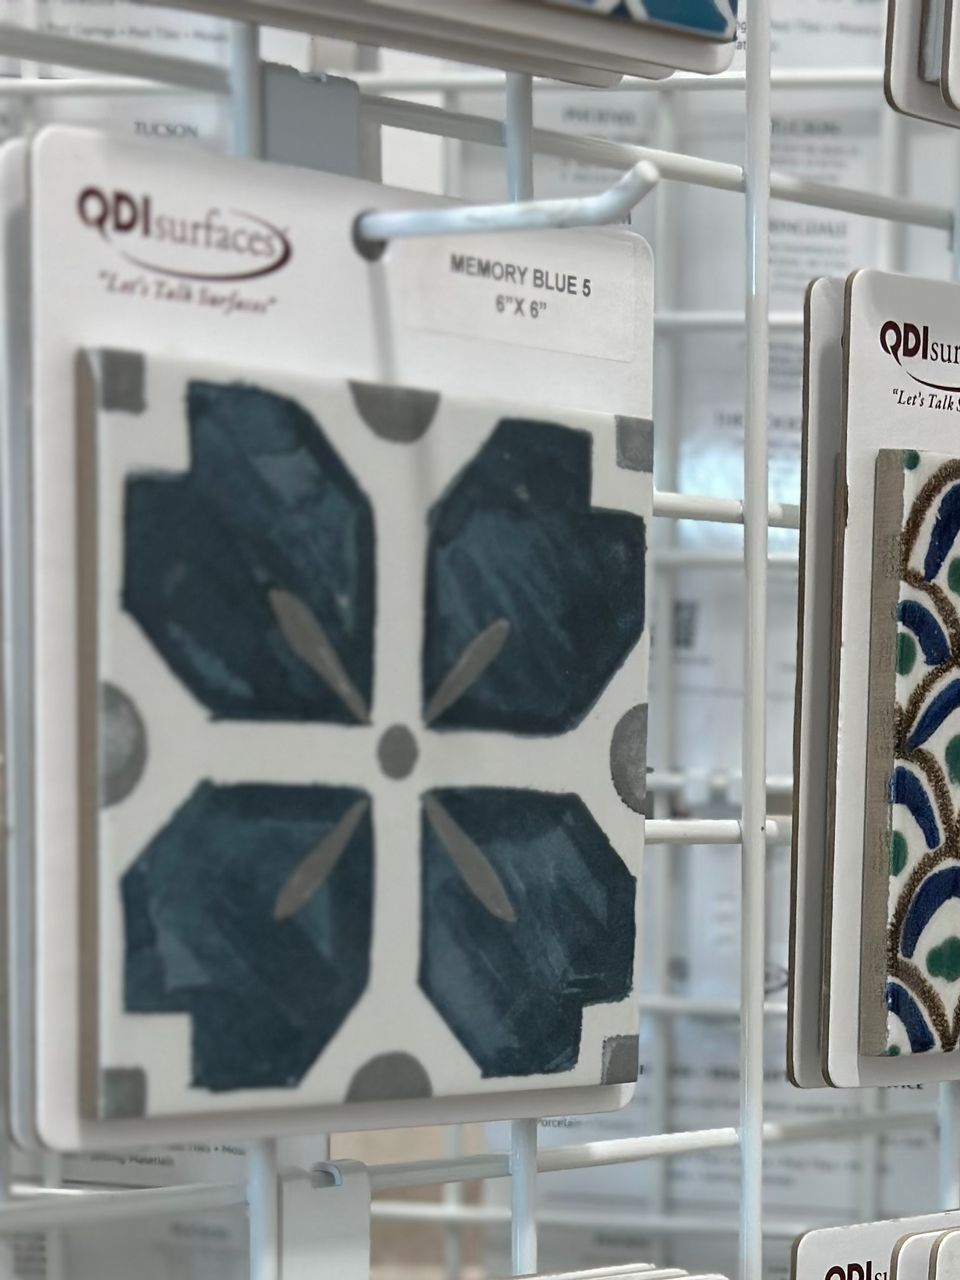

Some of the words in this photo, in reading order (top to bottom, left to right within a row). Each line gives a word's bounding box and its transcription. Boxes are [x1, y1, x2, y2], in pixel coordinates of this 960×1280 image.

[135, 121, 199, 138] TUCSON
[450, 253, 528, 285] MEMORY
[532, 268, 577, 295] BLUE
[582, 279, 592, 298] 5
[530, 300, 547, 319] 6"
[892, 388, 925, 408] "Let's
[928, 393, 954, 411] Talk
